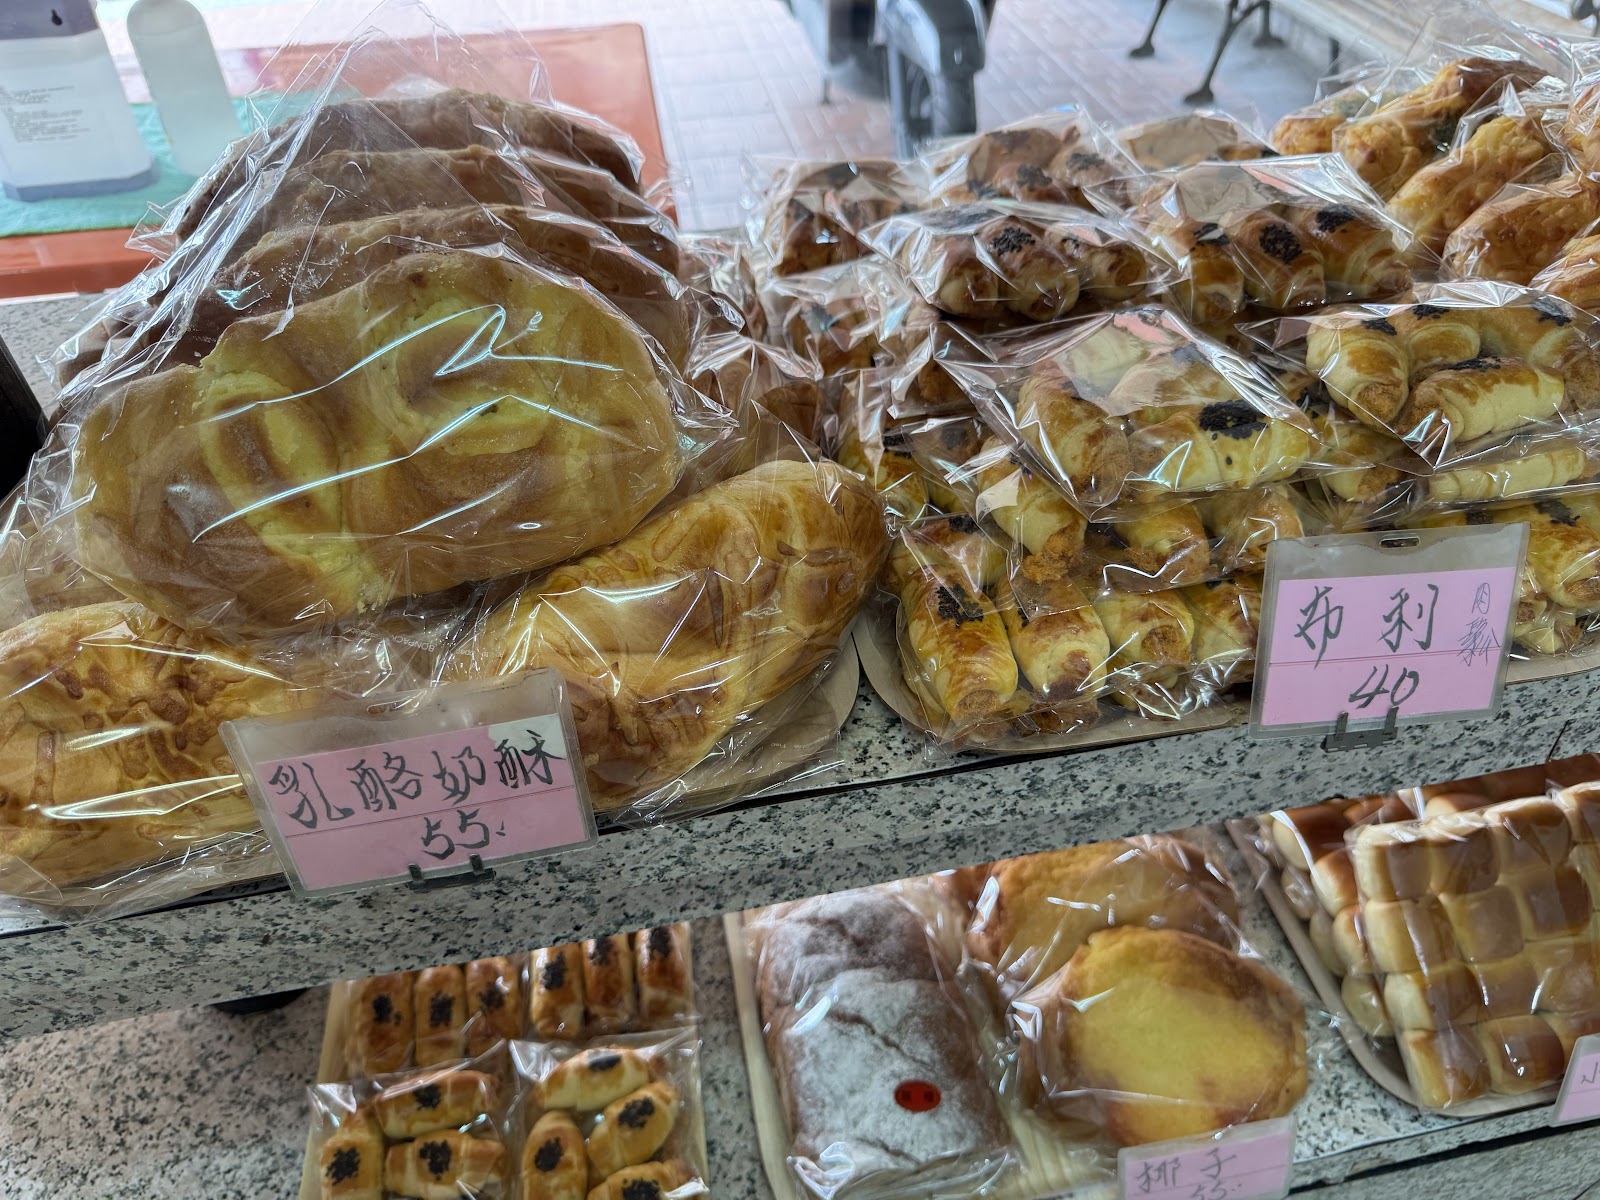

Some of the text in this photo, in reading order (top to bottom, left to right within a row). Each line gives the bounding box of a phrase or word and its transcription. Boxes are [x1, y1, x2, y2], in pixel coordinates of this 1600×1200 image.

[391, 634, 436, 653] BONPACK
[1294, 583, 1440, 669] 布利
[1348, 664, 1420, 709] 40
[268, 729, 567, 829] 乳酪奶酥
